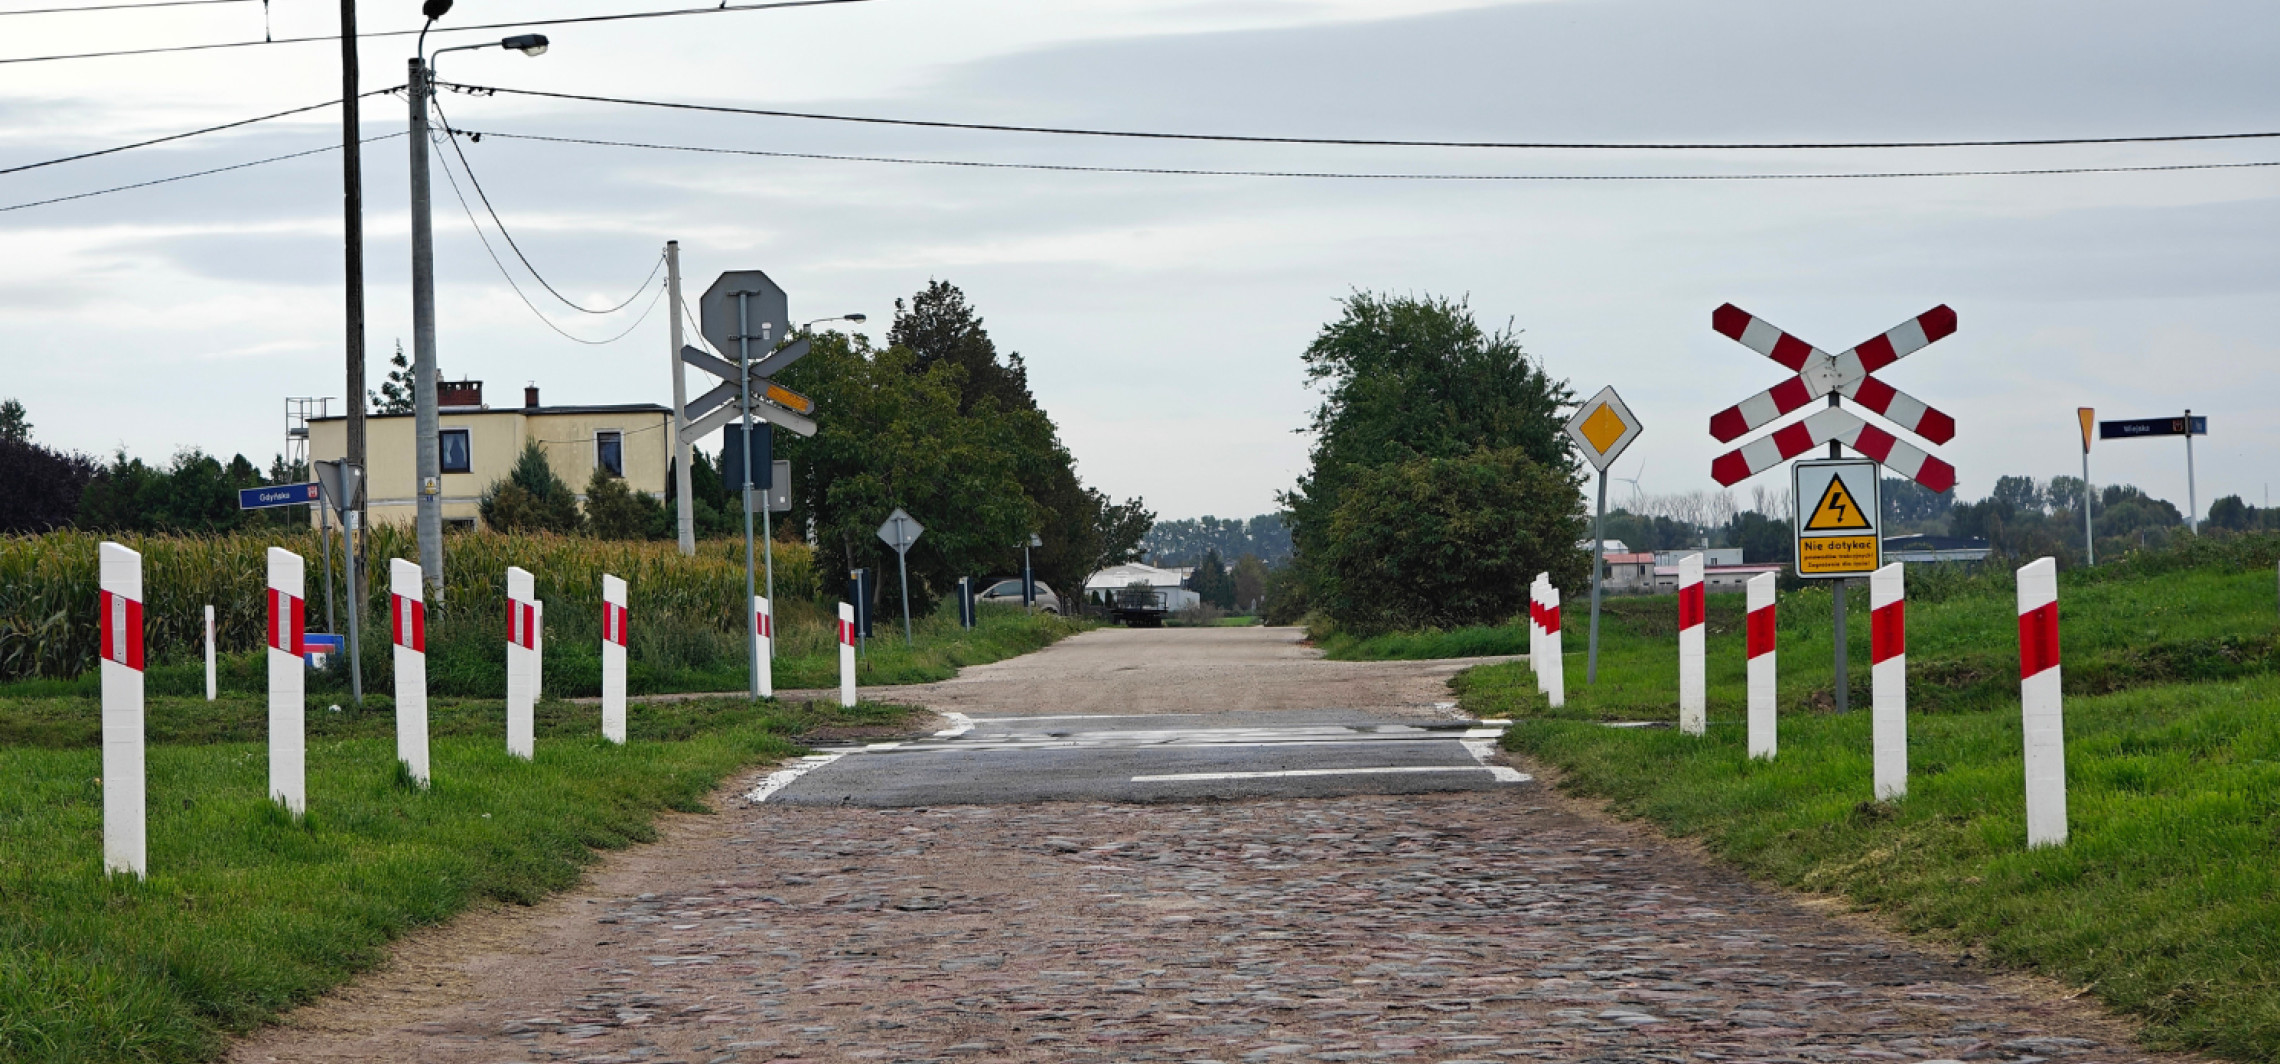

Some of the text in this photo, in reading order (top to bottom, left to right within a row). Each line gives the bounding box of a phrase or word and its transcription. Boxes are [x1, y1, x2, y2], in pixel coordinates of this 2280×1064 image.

[2123, 424, 2151, 434] Wiejska
[259, 491, 290, 502] Gdyńska
[1804, 540, 1872, 552] Nie dotykać
